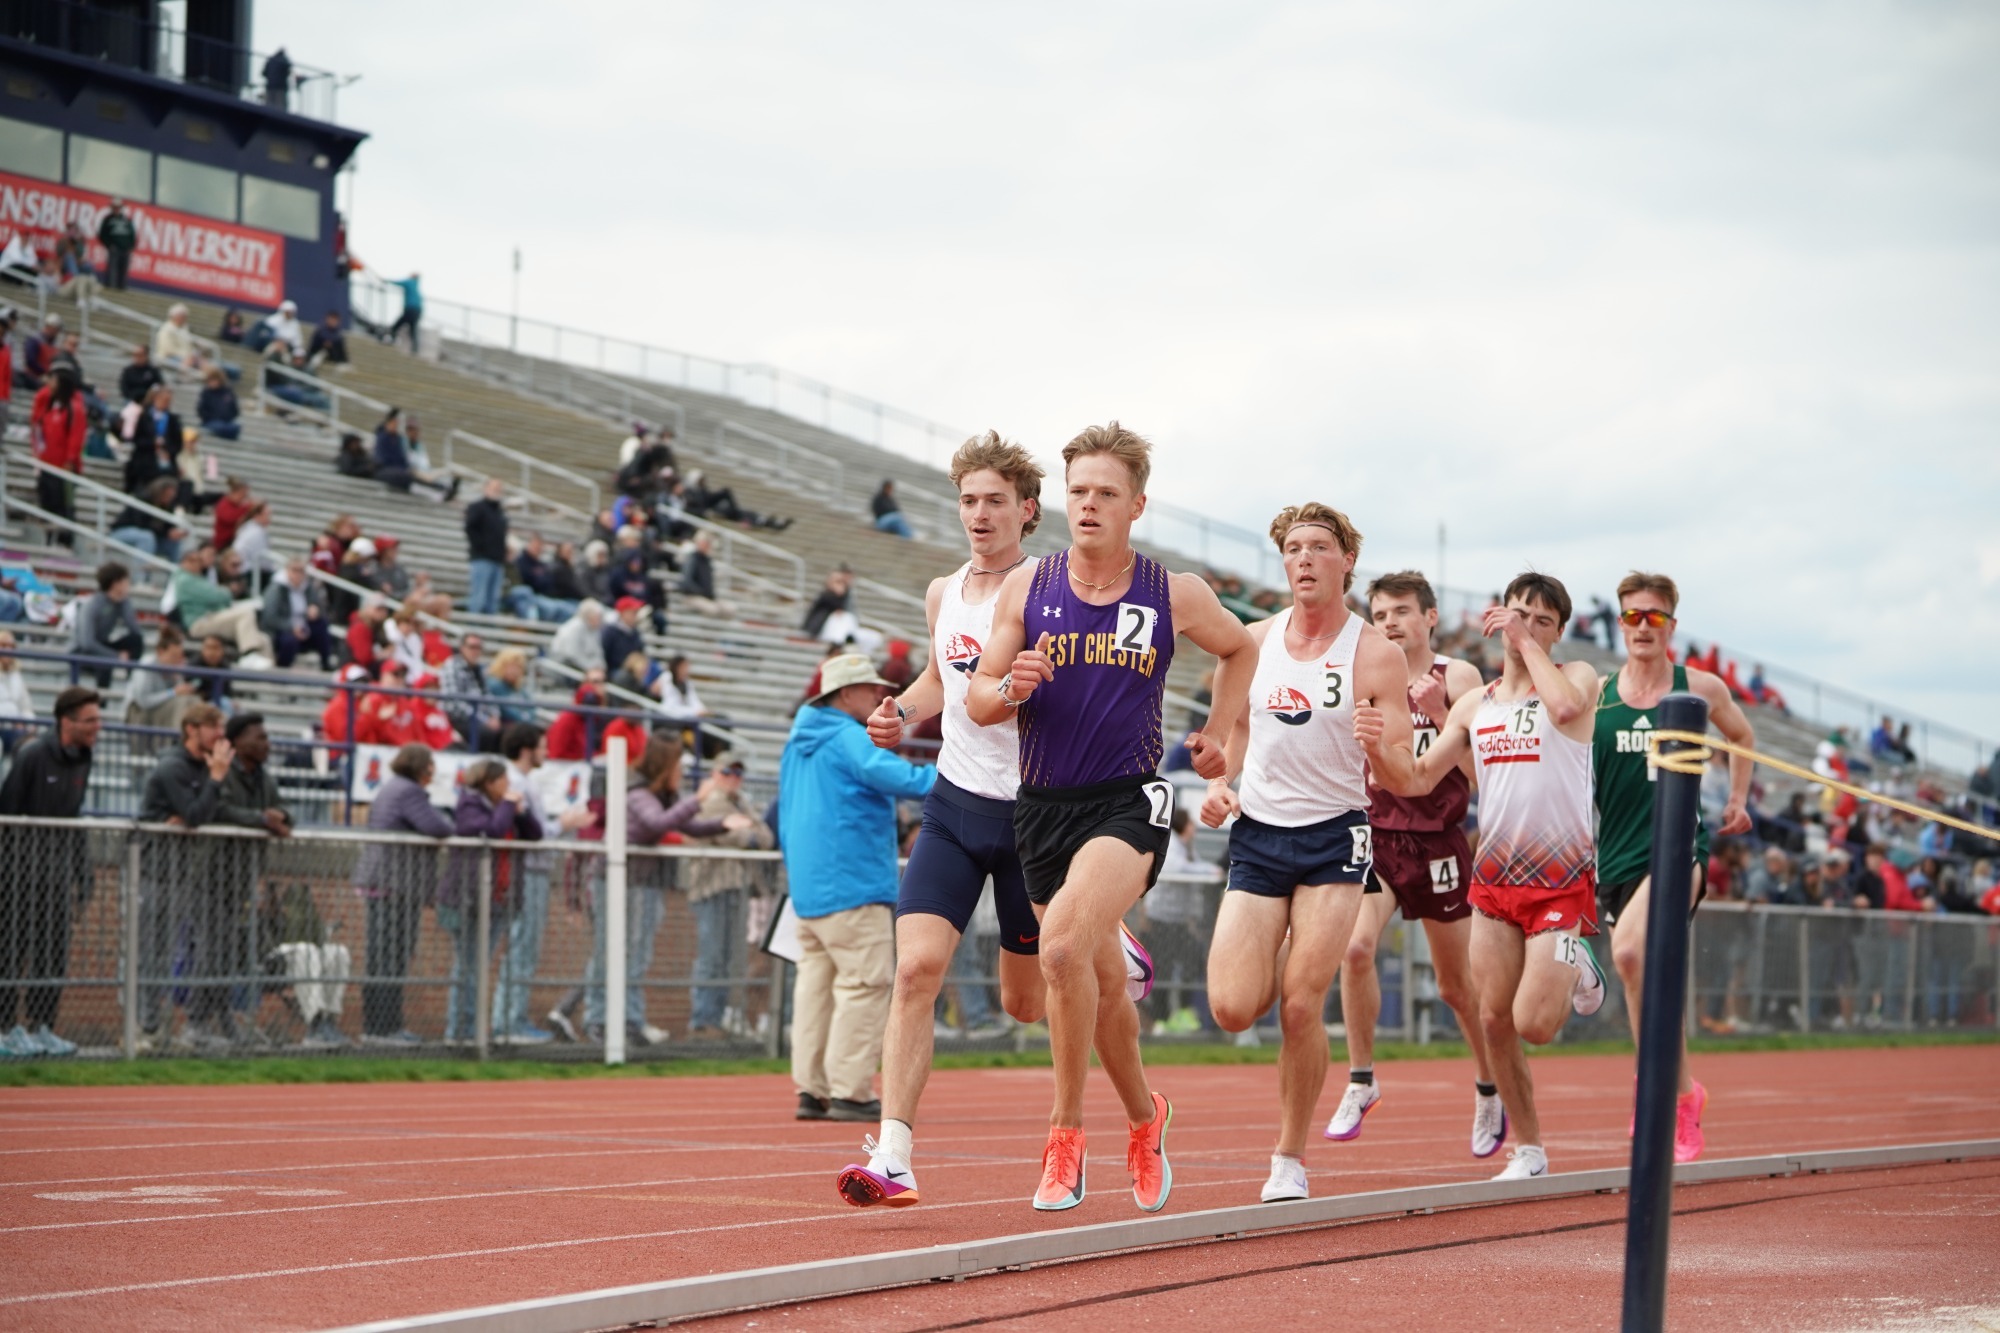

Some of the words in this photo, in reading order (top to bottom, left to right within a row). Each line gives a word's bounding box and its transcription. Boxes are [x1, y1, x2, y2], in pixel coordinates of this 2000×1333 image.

[0, 184, 112, 238] NSBUR
[1121, 608, 1145, 650] 2
[1035, 632, 1079, 668] EST
[1323, 672, 1342, 708] 3
[1515, 708, 1537, 735] 15
[1416, 732, 1430, 758] 4
[1151, 784, 1169, 825] 2
[1356, 828, 1368, 862] 3
[1438, 861, 1454, 890] 4
[1563, 937, 1577, 964] 15
